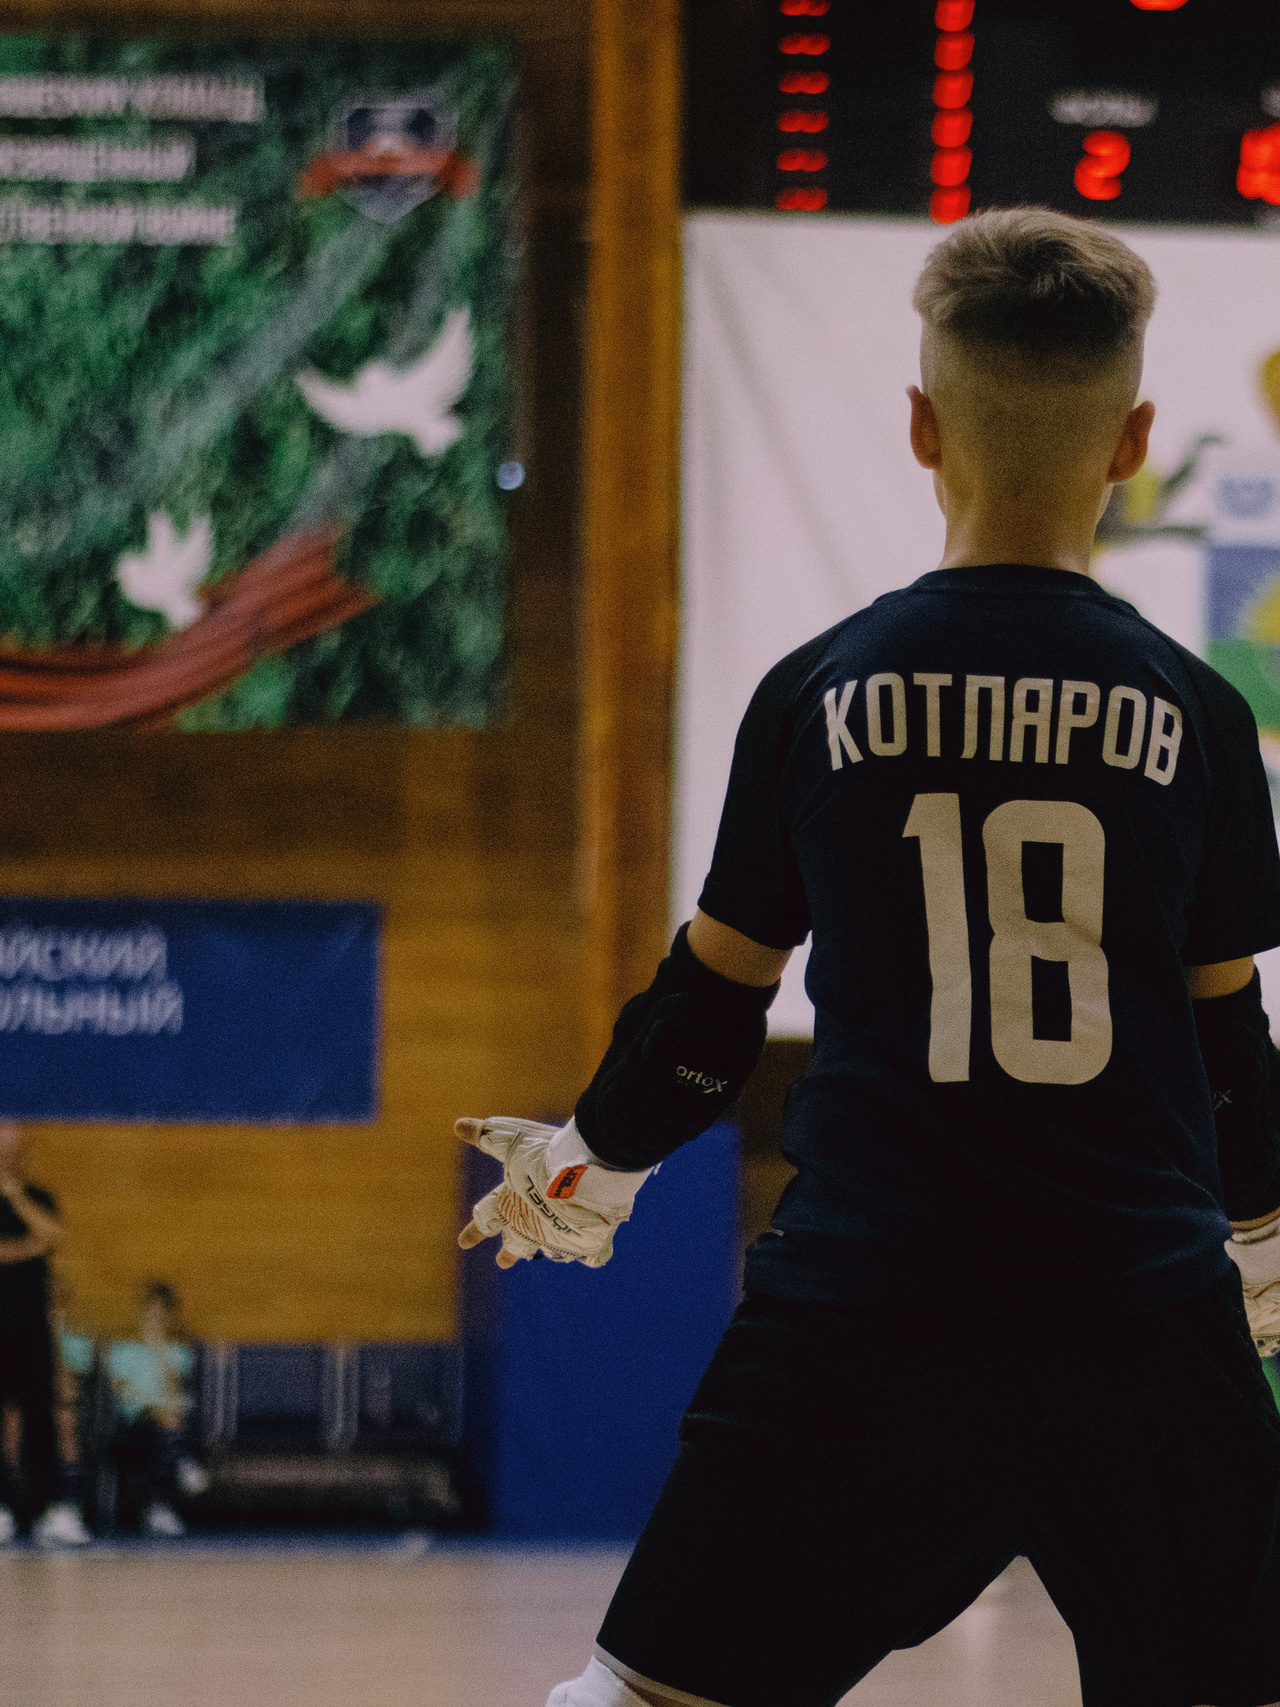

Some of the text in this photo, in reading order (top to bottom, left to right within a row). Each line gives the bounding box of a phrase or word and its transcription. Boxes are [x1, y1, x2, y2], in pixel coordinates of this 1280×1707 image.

[1074, 130, 1131, 201] 2
[823, 672, 1184, 786] КОТЛЯРОВ
[0, 920, 167, 980] ЙСКИЙ
[902, 792, 1114, 1085] 18
